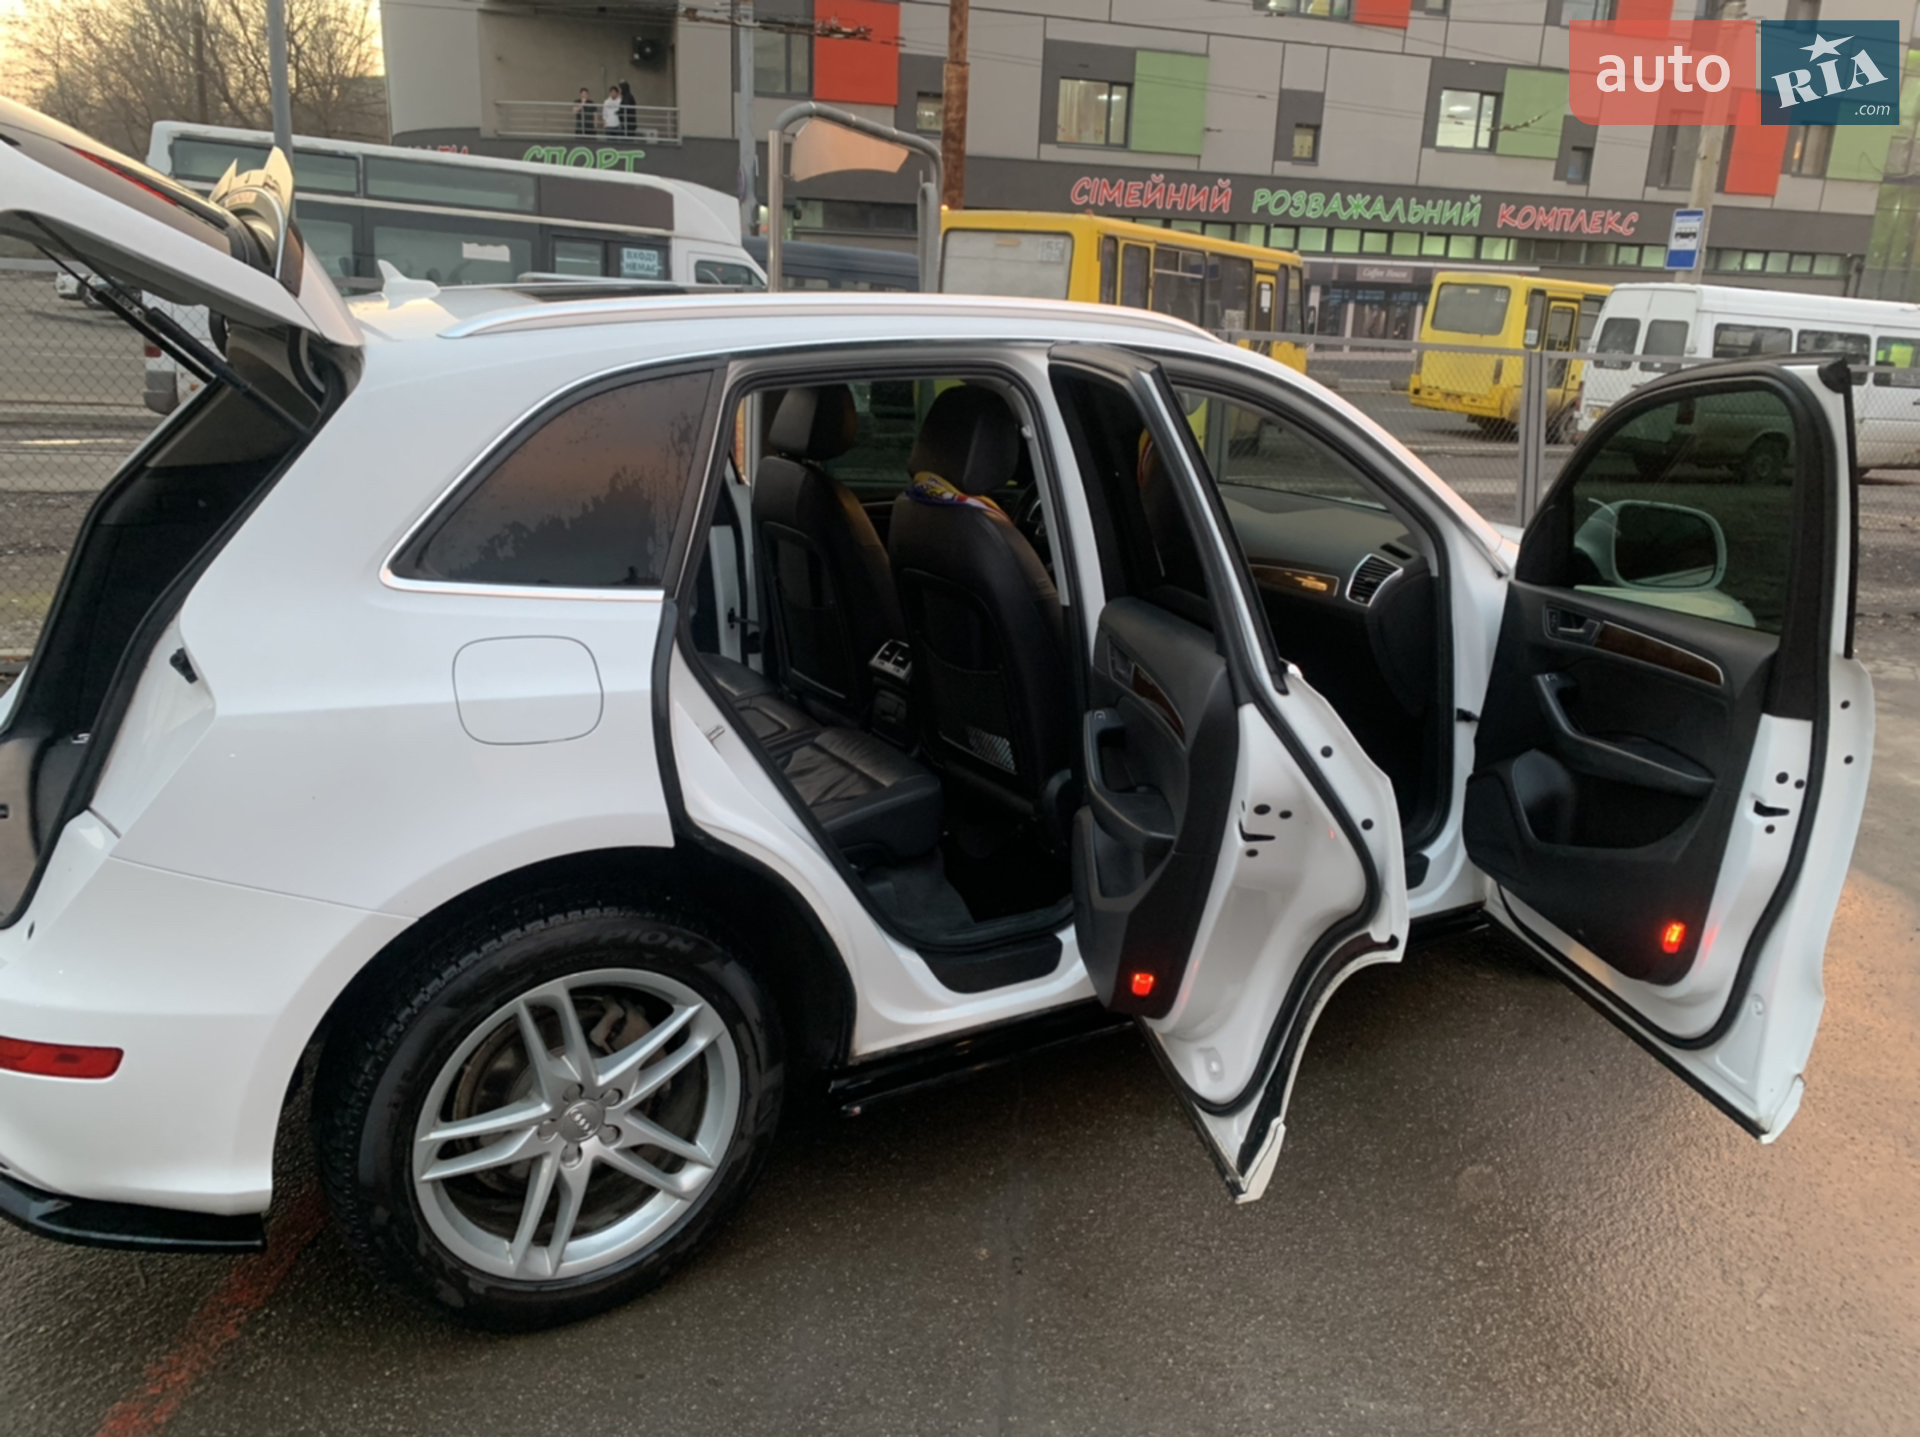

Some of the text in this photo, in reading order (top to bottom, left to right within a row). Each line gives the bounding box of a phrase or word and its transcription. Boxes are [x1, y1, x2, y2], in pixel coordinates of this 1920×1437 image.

[523, 145, 645, 173] СПОРТ
[1070, 173, 1639, 236] СІМЕЙНИЙ РОЗВАЖАЛЬНИЙ КОМПЛЕКС
